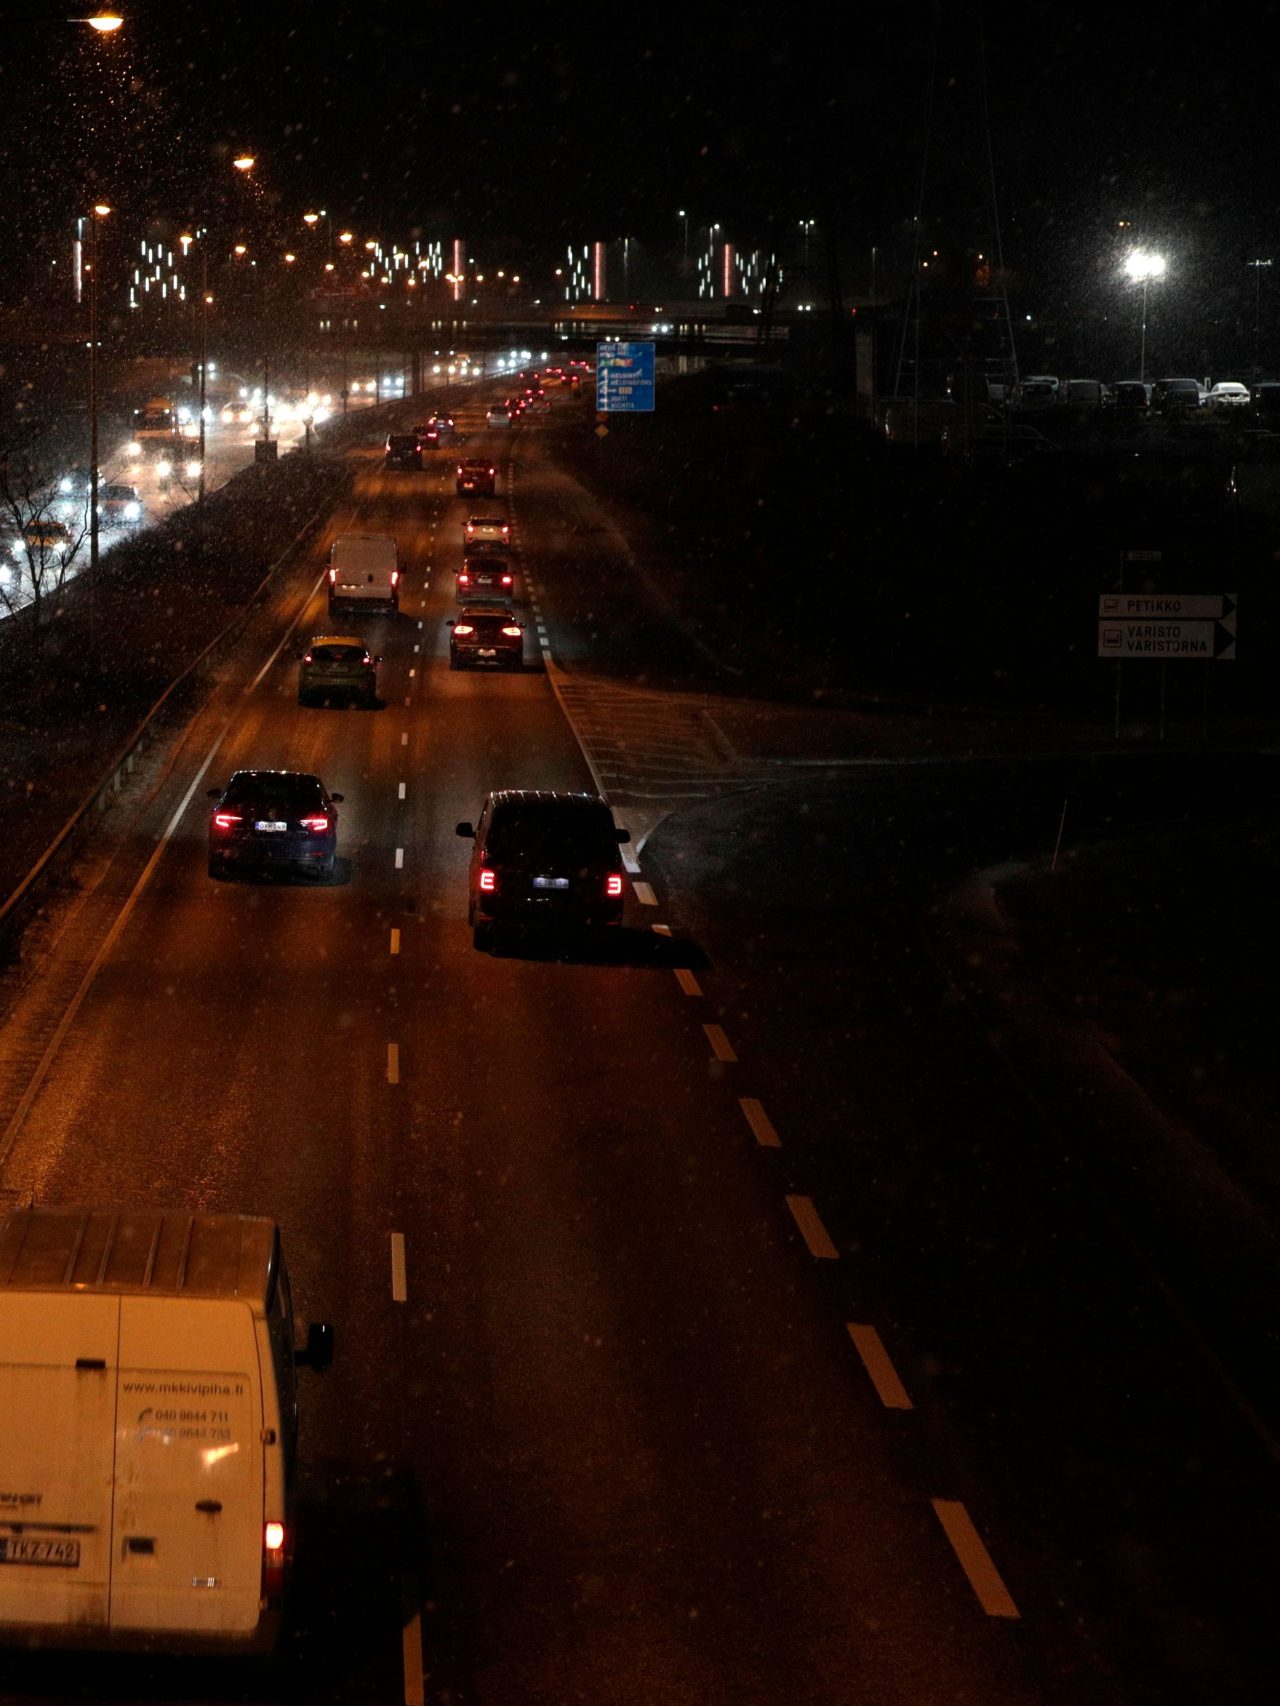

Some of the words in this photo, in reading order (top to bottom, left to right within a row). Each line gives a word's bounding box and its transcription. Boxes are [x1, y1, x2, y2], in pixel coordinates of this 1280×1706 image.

[1127, 600, 1181, 612] PETIKKO
[1127, 626, 1181, 638] VARISTO
[1127, 640, 1208, 652] VARISTORNA
